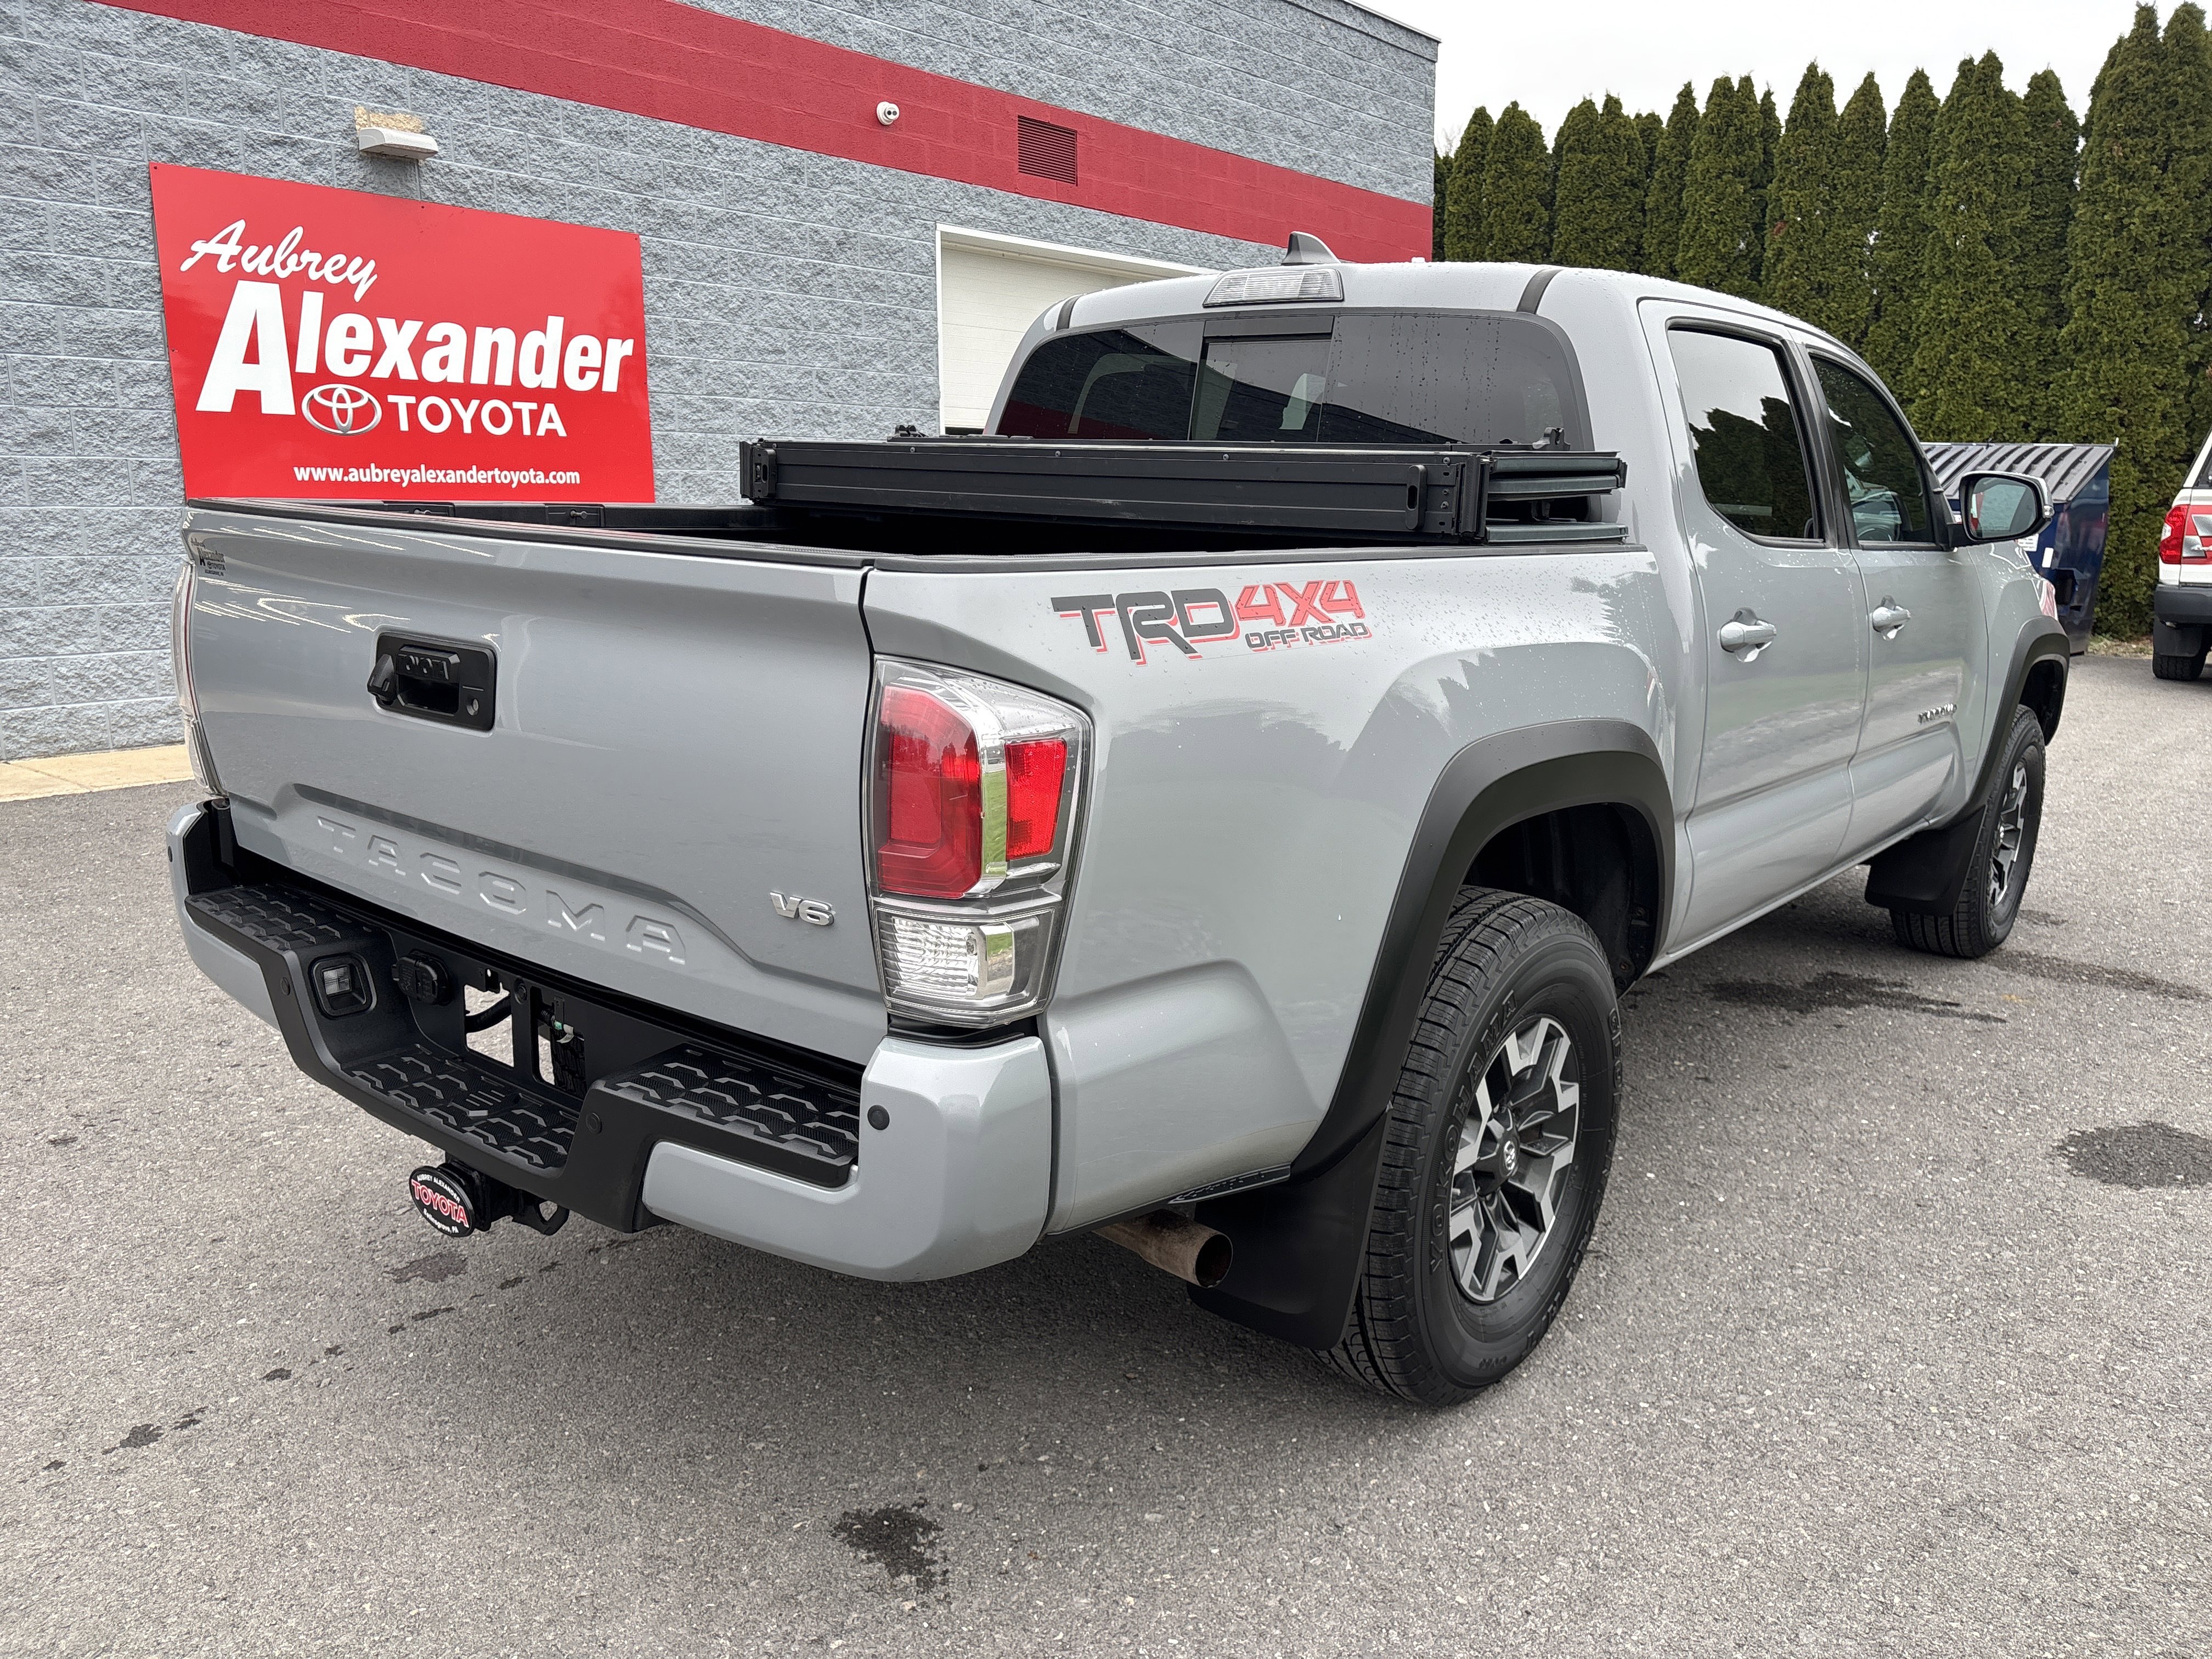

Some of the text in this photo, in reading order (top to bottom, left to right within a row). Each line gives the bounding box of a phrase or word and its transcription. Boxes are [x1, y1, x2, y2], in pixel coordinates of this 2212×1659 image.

[180, 219, 377, 302] Aubrey
[196, 280, 634, 415] Alexander
[387, 394, 567, 437] TOYOTA
[294, 463, 580, 488] www.aubreyalexandertoyota.com
[1050, 588, 1241, 667] TRD
[1244, 622, 1373, 652] OFF ROAD
[318, 816, 686, 965] TACOMA
[770, 891, 834, 926] V6
[411, 1178, 469, 1228] TOYOTA
[433, 1177, 460, 1203] ALEXANDER
